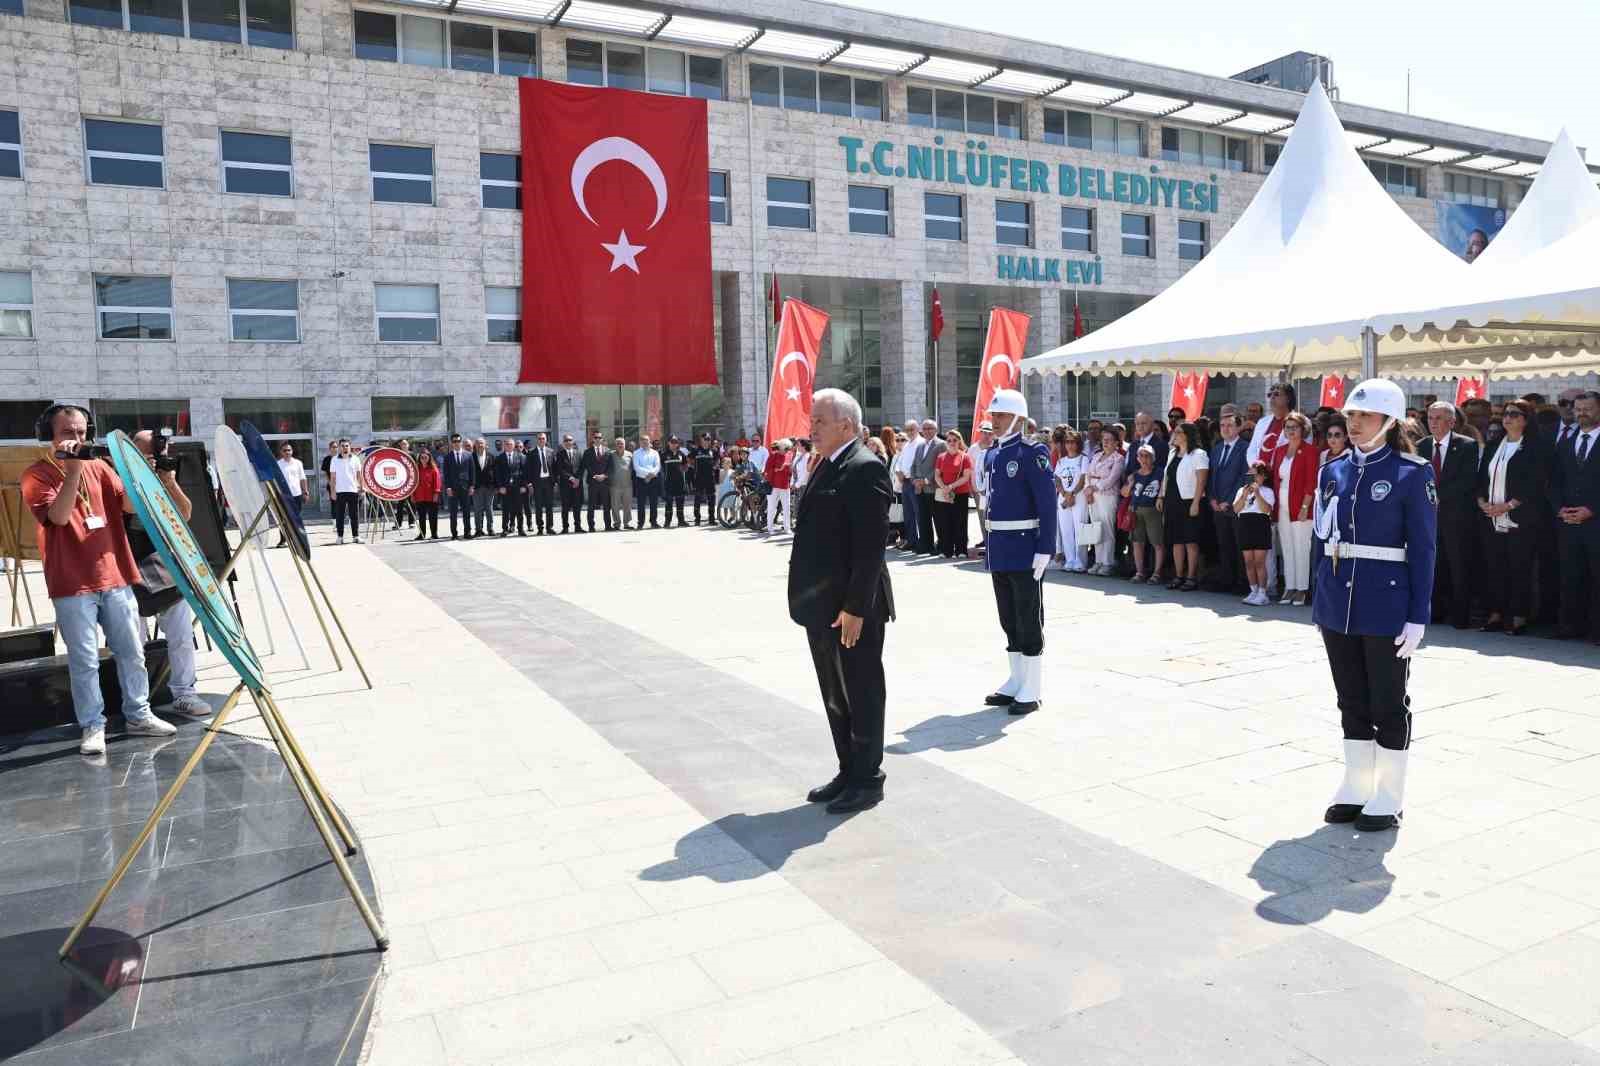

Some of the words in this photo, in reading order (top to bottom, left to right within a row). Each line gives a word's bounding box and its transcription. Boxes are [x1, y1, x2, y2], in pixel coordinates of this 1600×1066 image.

[1058, 164, 1218, 213] BELEDİYESİ
[998, 254, 1060, 283] HALK
[1066, 254, 1103, 285] EVİ
